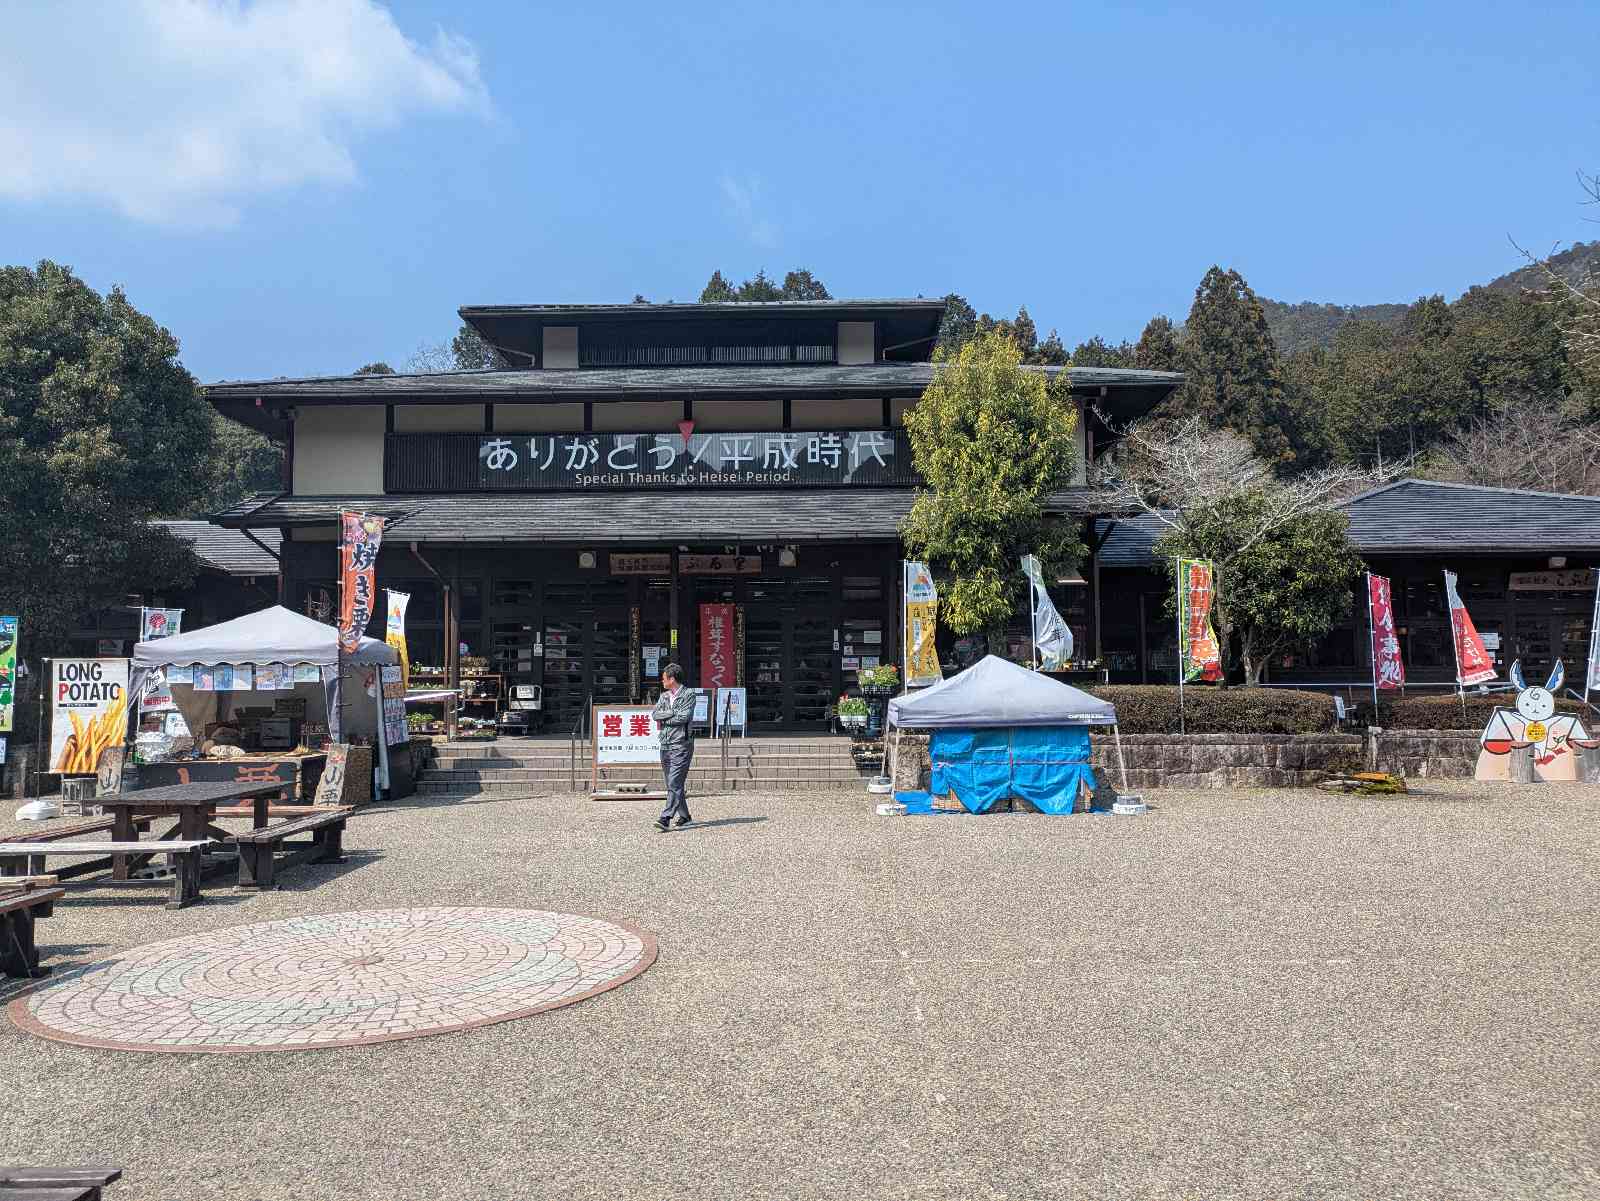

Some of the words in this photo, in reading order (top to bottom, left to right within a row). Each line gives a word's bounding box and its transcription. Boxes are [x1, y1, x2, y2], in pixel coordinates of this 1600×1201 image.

[575, 473, 624, 486] Special
[628, 472, 676, 484] Thanks
[681, 473, 694, 483] to
[699, 472, 742, 483] Heisei
[59, 663, 103, 682] LONG
[59, 683, 121, 701] POTATO
[603, 714, 664, 737] 営業
